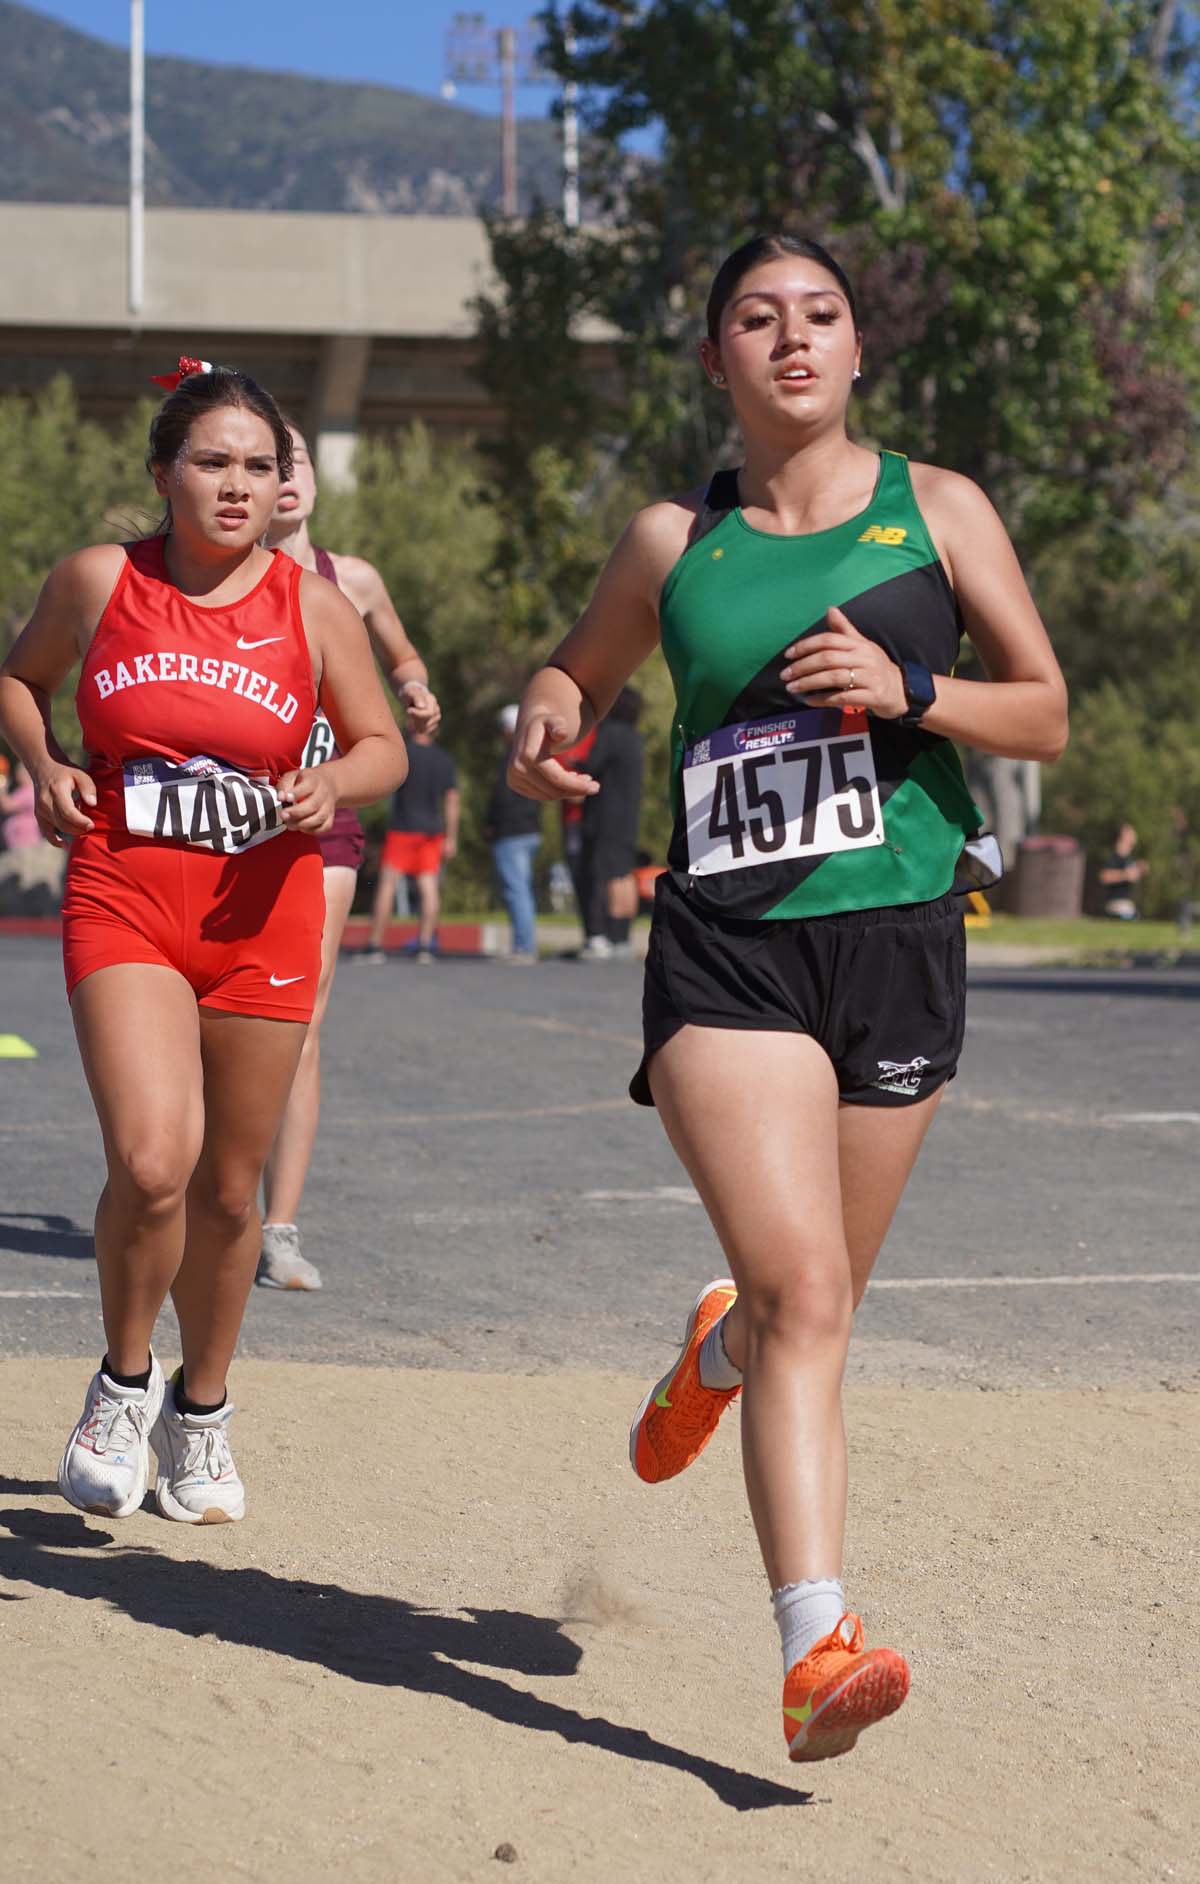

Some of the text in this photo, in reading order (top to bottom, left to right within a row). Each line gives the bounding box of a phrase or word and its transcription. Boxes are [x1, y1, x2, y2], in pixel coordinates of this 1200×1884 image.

[94, 652, 299, 724] BAKERSFIELD
[745, 731, 796, 750] RESULTS
[746, 719, 796, 738] FINISHED
[708, 739, 876, 859] 4575
